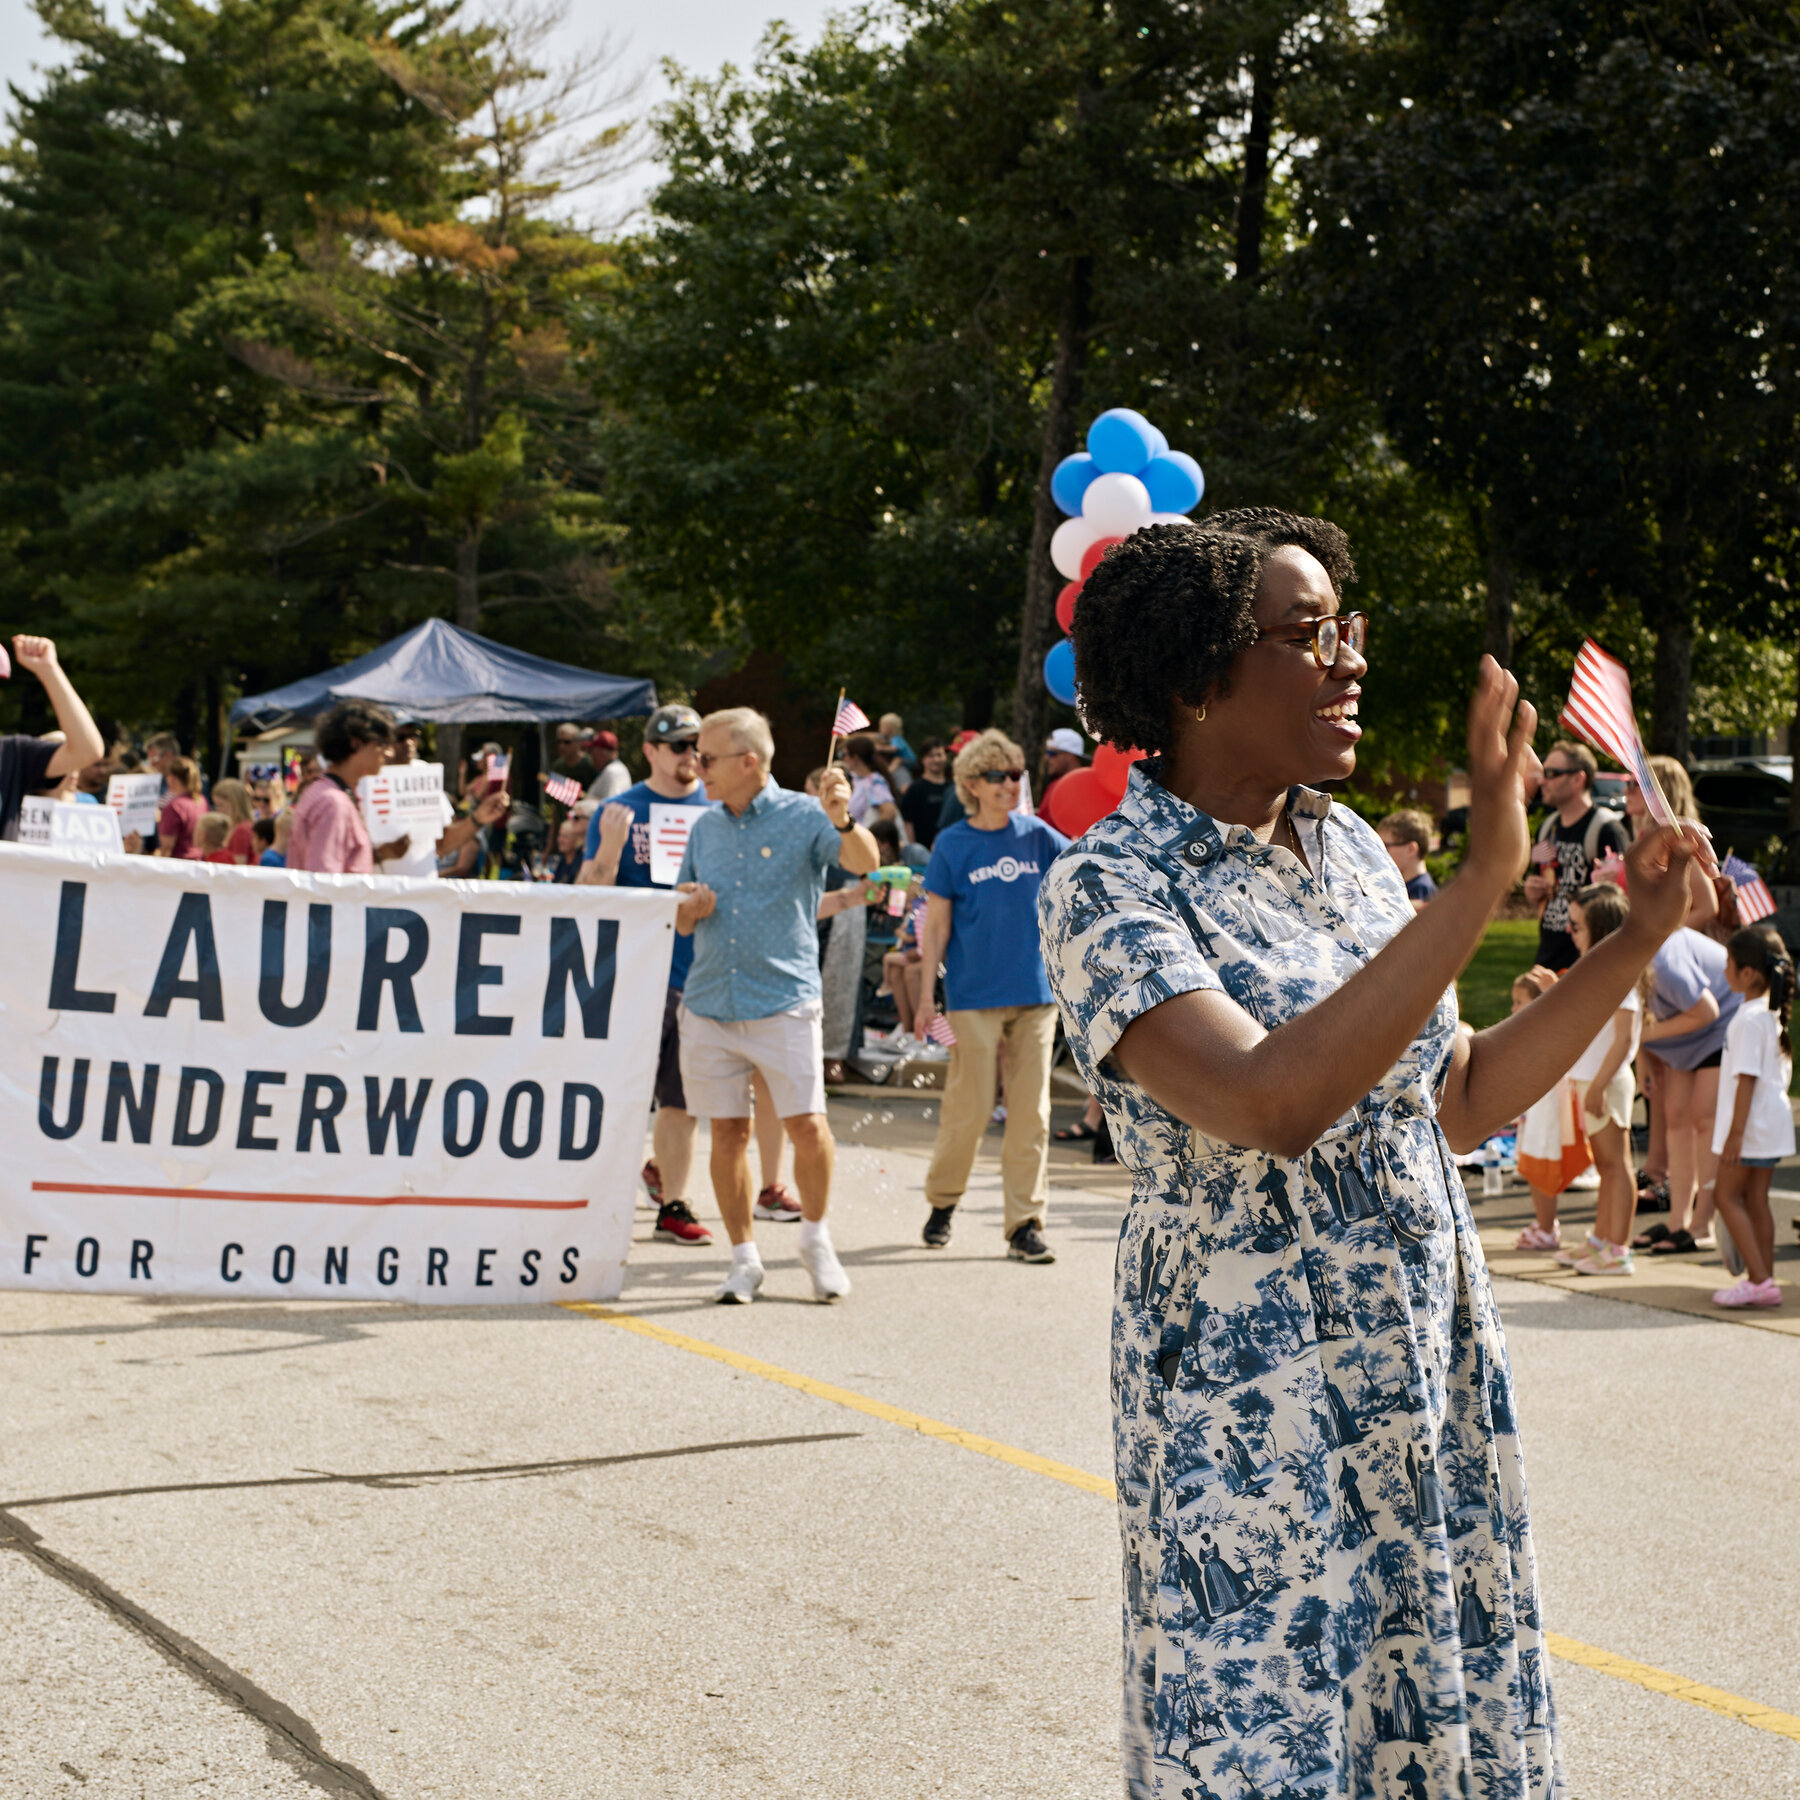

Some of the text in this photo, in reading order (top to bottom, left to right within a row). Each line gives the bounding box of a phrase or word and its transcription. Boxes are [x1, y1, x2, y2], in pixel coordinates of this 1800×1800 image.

[48, 881, 620, 1040] LAUREN
[38, 1056, 604, 1162] UNDERWOOD
[24, 1234, 580, 1287] FOR CONGRESS
